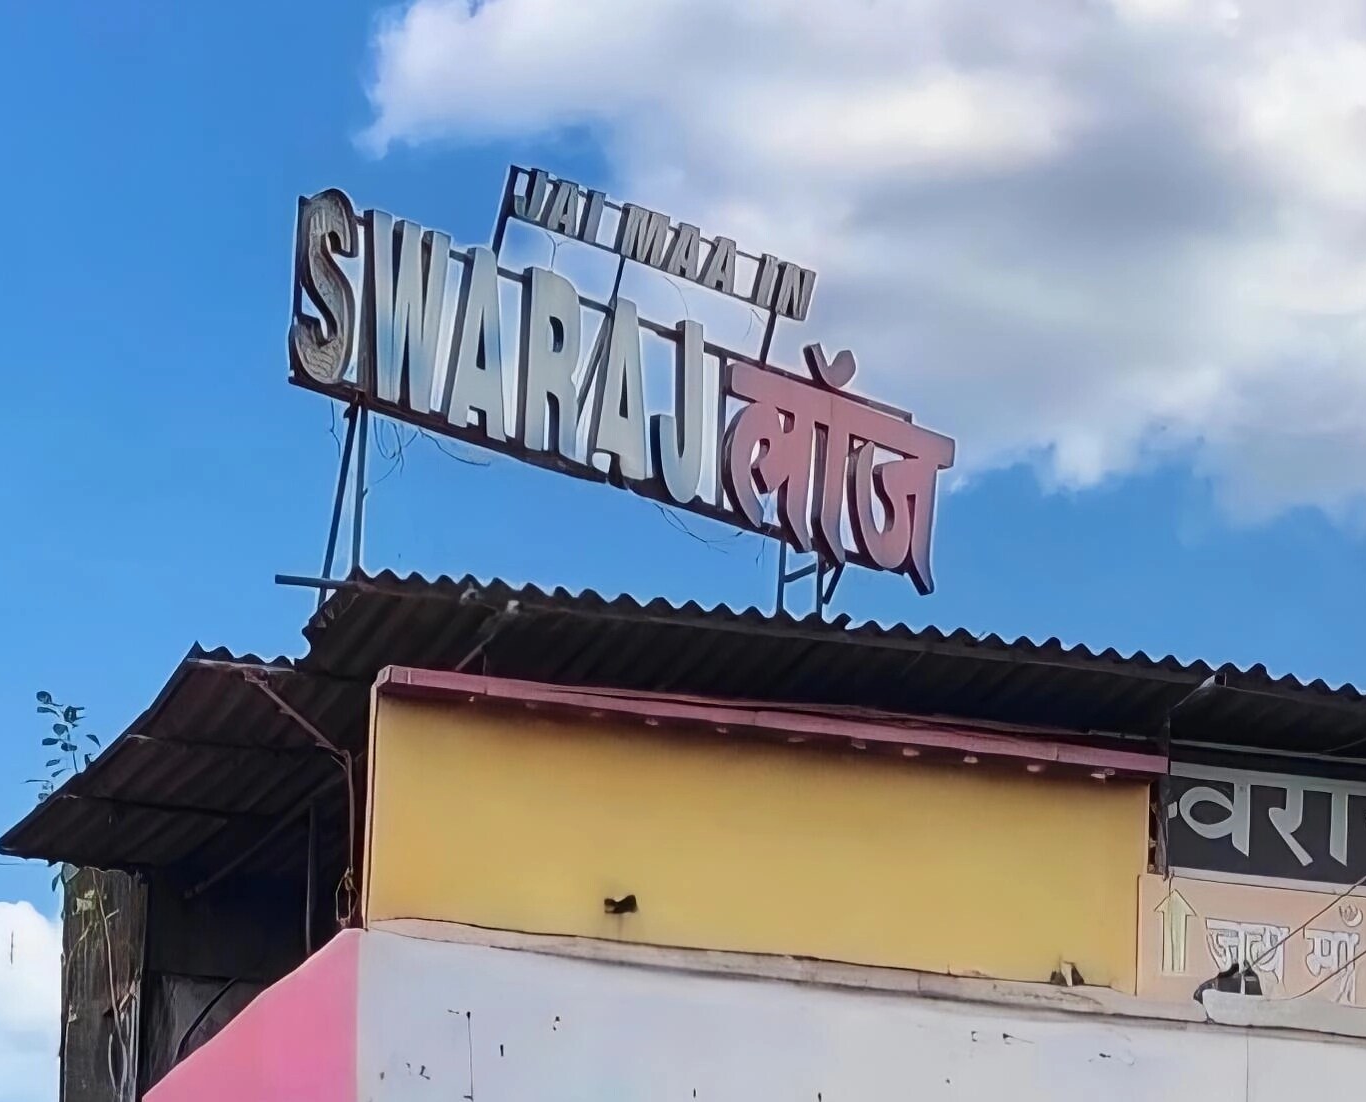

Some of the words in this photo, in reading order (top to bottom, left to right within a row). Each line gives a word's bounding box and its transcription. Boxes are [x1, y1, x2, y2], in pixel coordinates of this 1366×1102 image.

[289, 188, 705, 504] SWARAJ
[511, 167, 606, 244] JAI
[614, 203, 737, 297] MAA
[751, 252, 817, 321] IN
[721, 342, 956, 596] लॉज
